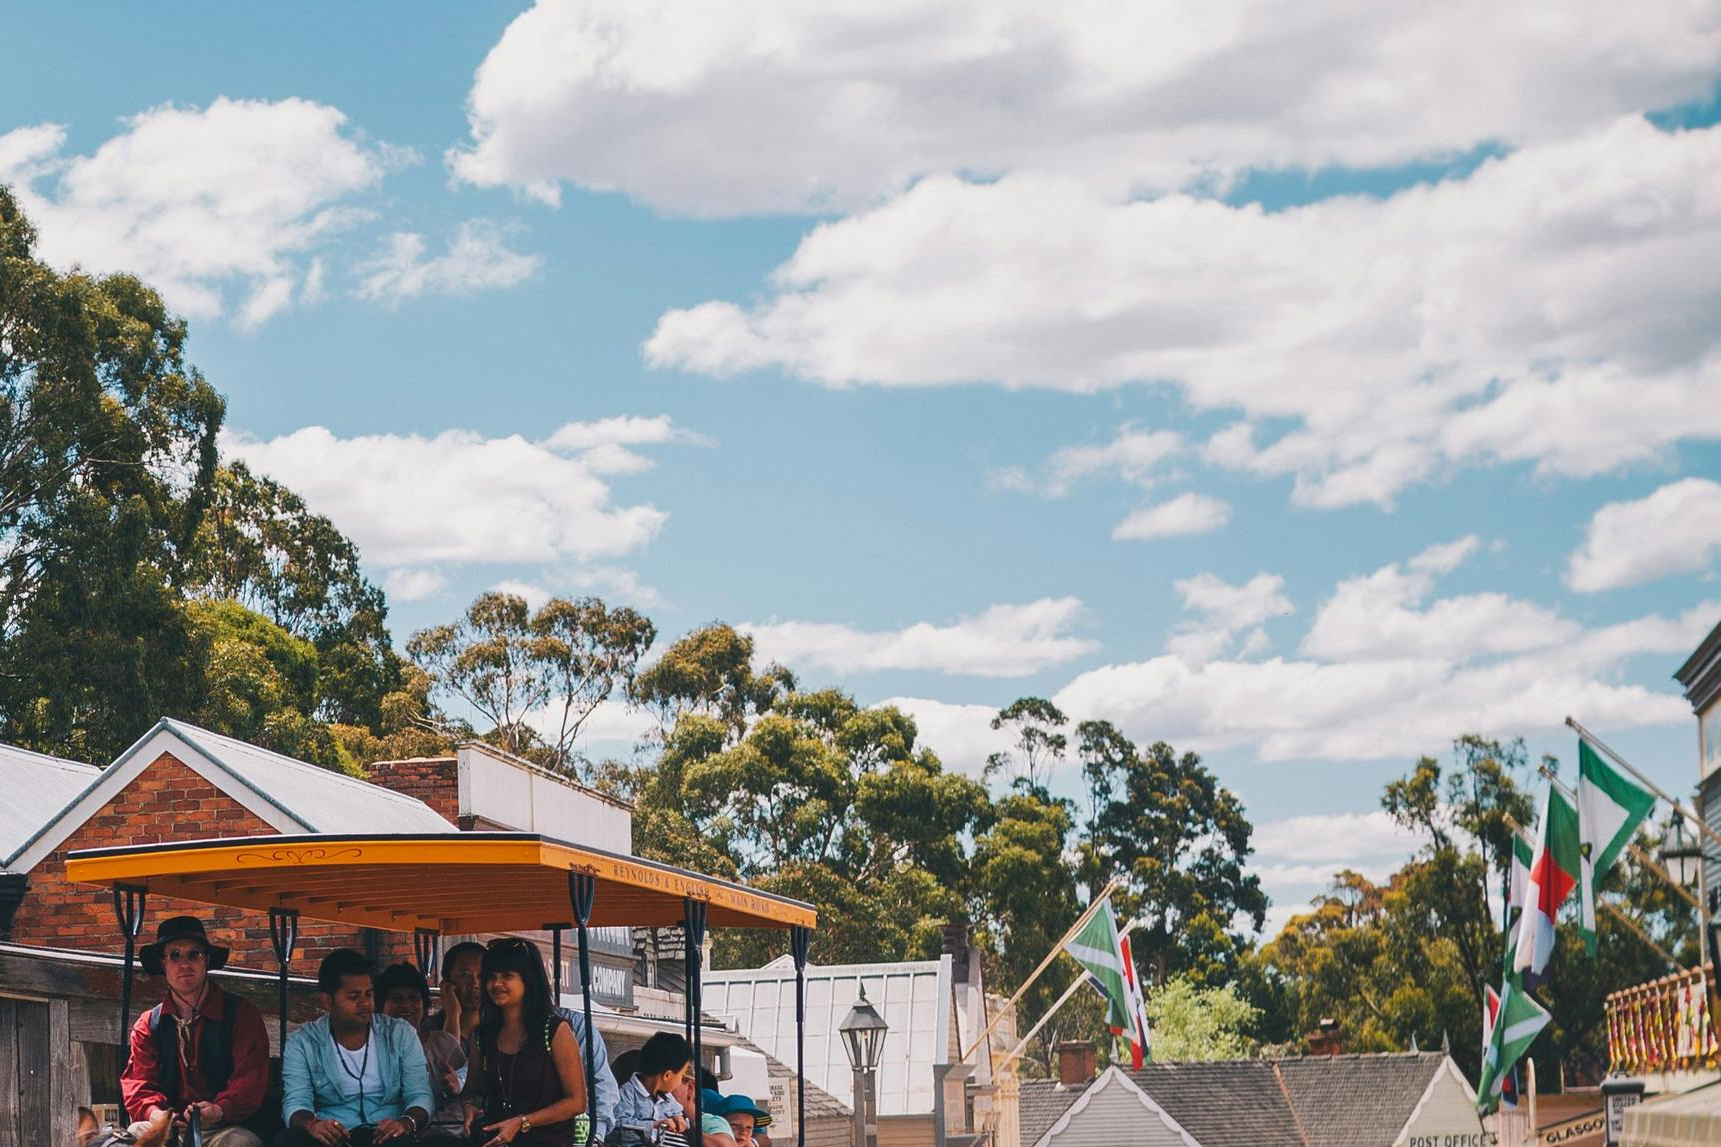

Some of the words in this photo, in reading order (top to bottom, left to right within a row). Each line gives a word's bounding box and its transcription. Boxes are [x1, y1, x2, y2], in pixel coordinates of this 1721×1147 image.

[613, 864, 659, 886] REYNOLDS
[664, 877, 670, 889] &
[675, 880, 710, 897] ENGLISH
[592, 965, 626, 997] COMPANY
[1546, 1117, 1604, 1144] GLASGO
